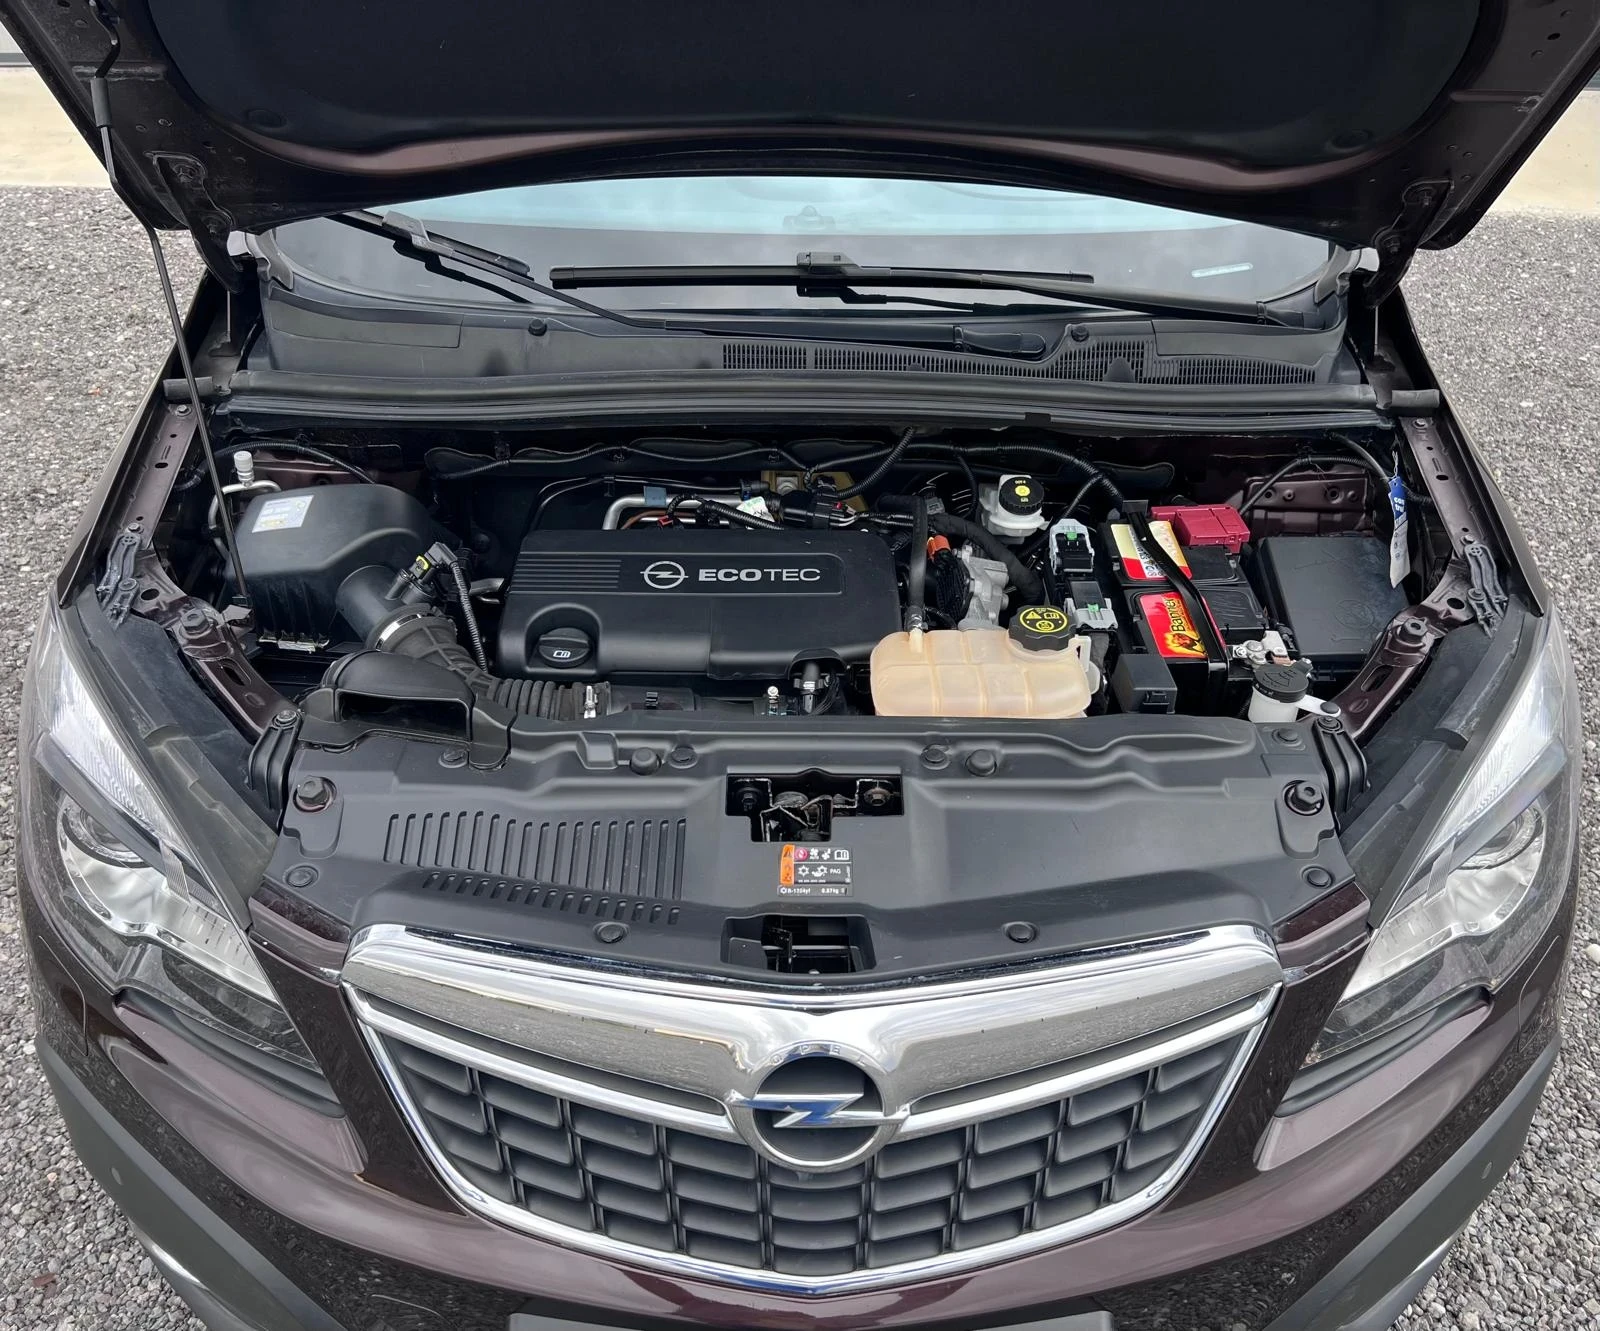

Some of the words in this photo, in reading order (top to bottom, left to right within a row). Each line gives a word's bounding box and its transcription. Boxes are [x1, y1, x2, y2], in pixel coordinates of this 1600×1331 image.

[698, 568, 821, 581] ECOTEC
[1166, 598, 1186, 632] Banner
[770, 1044, 866, 1067] OPEL
